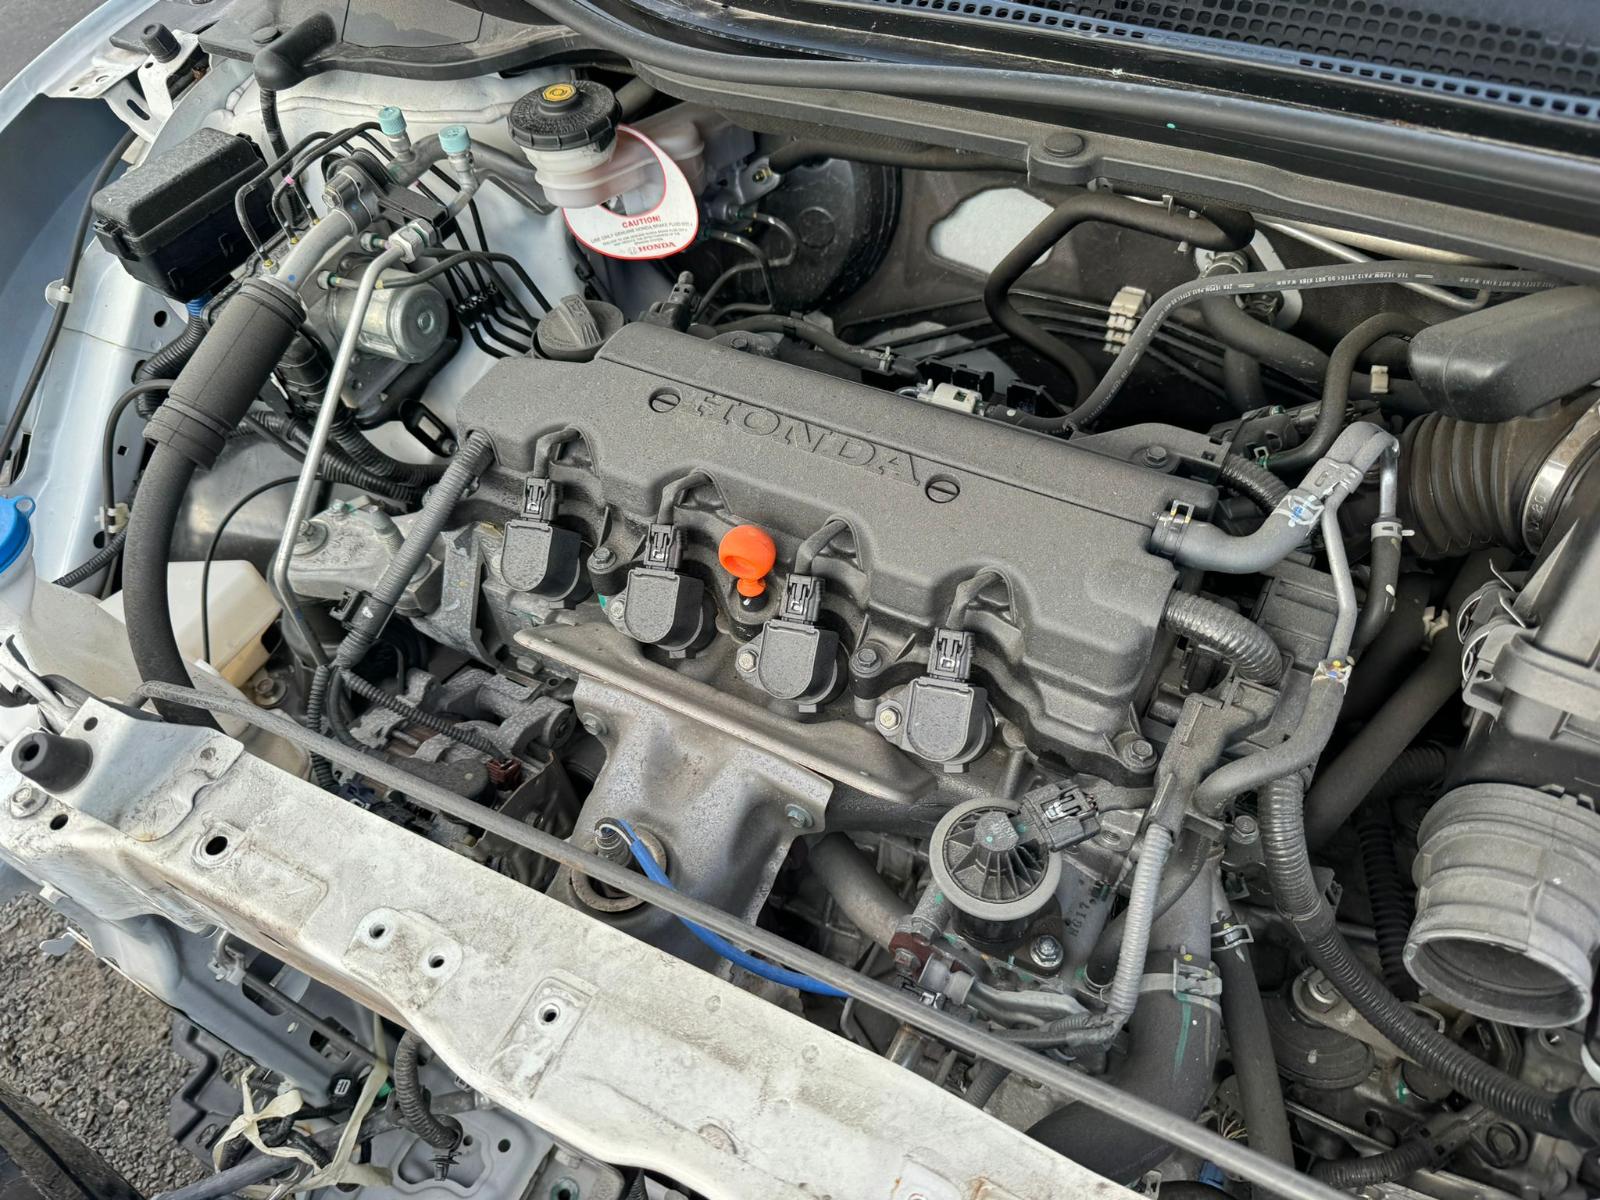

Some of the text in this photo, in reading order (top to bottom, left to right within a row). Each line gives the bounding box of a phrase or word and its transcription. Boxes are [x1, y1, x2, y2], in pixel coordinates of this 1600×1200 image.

[622, 215, 662, 229] CAUTION!
[637, 241, 677, 252] HONDA
[680, 391, 920, 487] HONDA
